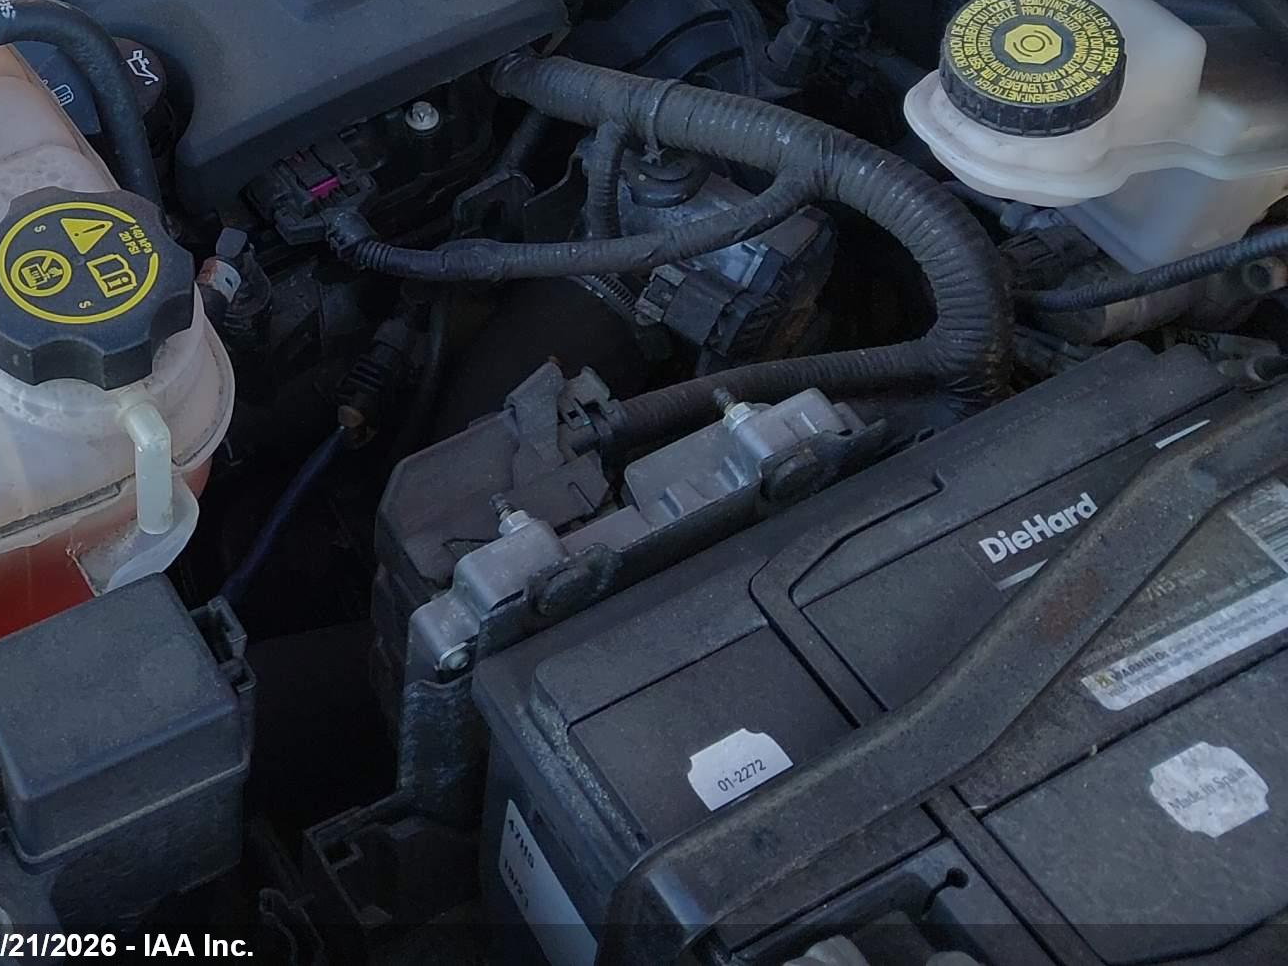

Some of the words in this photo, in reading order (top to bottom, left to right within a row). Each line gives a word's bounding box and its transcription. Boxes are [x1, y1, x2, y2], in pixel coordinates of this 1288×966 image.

[973, 11, 988, 24] DU
[1021, 6, 1045, 16] FROM
[1046, 9, 1054, 18] A
[1053, 11, 1081, 32] SEALED
[1071, 9, 1090, 24] USE
[1084, 5, 1111, 28] FILLER
[951, 25, 964, 35] DE
[1083, 21, 1102, 37] ONLY
[1102, 28, 1118, 45] CAP
[1090, 38, 1104, 50] DOT
[951, 37, 968, 68] BOUCHON
[1097, 47, 1119, 75] BEFORE
[963, 68, 977, 80] LE
[1007, 68, 1061, 83] PROVENANT
[1062, 69, 1087, 88] AVANT
[1044, 83, 1058, 92] DE
[119, 231, 132, 242] 20
[129, 225, 145, 239] 140
[125, 241, 141, 255] PSI
[978, 492, 1099, 564] DieHard
[717, 758, 767, 793] 01-2272
[1168, 791, 1202, 811] Made
[1201, 782, 1217, 797] in
[1213, 767, 1250, 793] Spain
